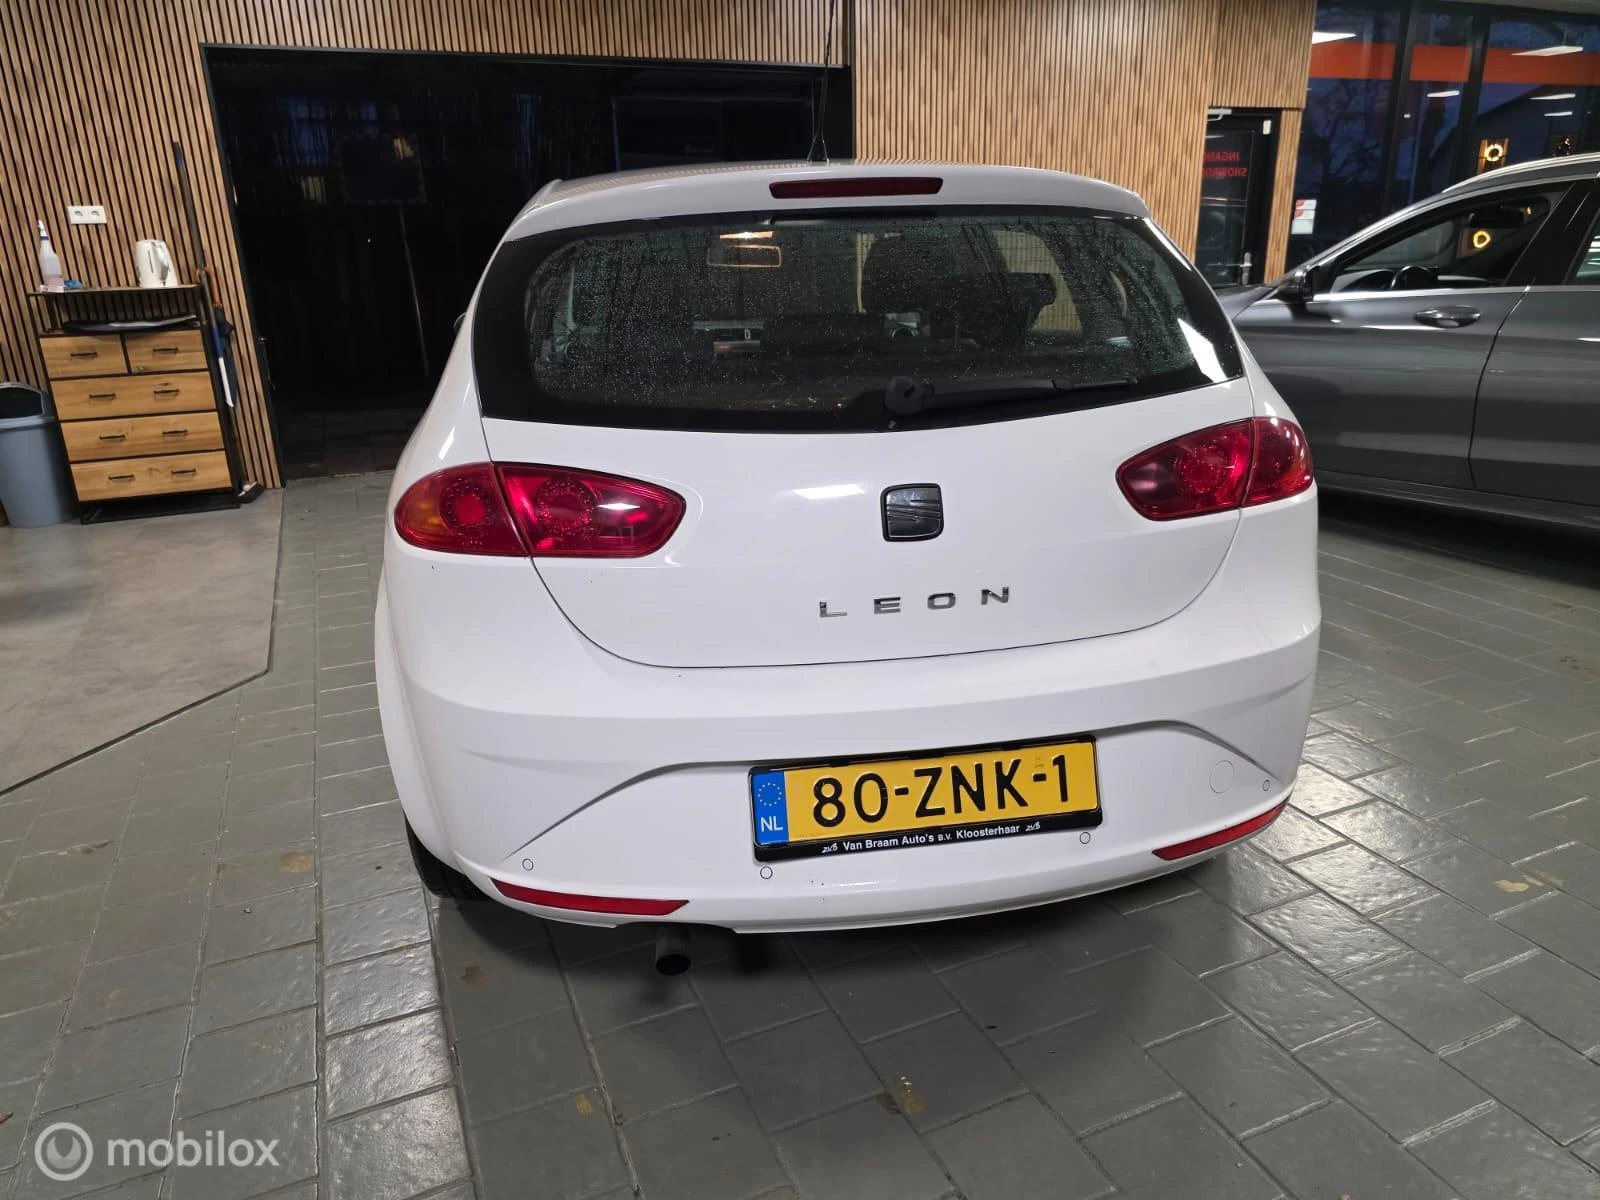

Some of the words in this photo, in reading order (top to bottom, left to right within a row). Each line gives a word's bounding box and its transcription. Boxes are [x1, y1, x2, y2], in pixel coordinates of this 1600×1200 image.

[819, 586, 1010, 618] LEON
[812, 754, 1069, 828] 80-ZNK-1
[760, 816, 784, 833] NL
[842, 839, 863, 851] Van
[865, 836, 899, 849] Braam
[901, 832, 935, 845] Auto's
[956, 824, 1021, 840] Kloosterhaar
